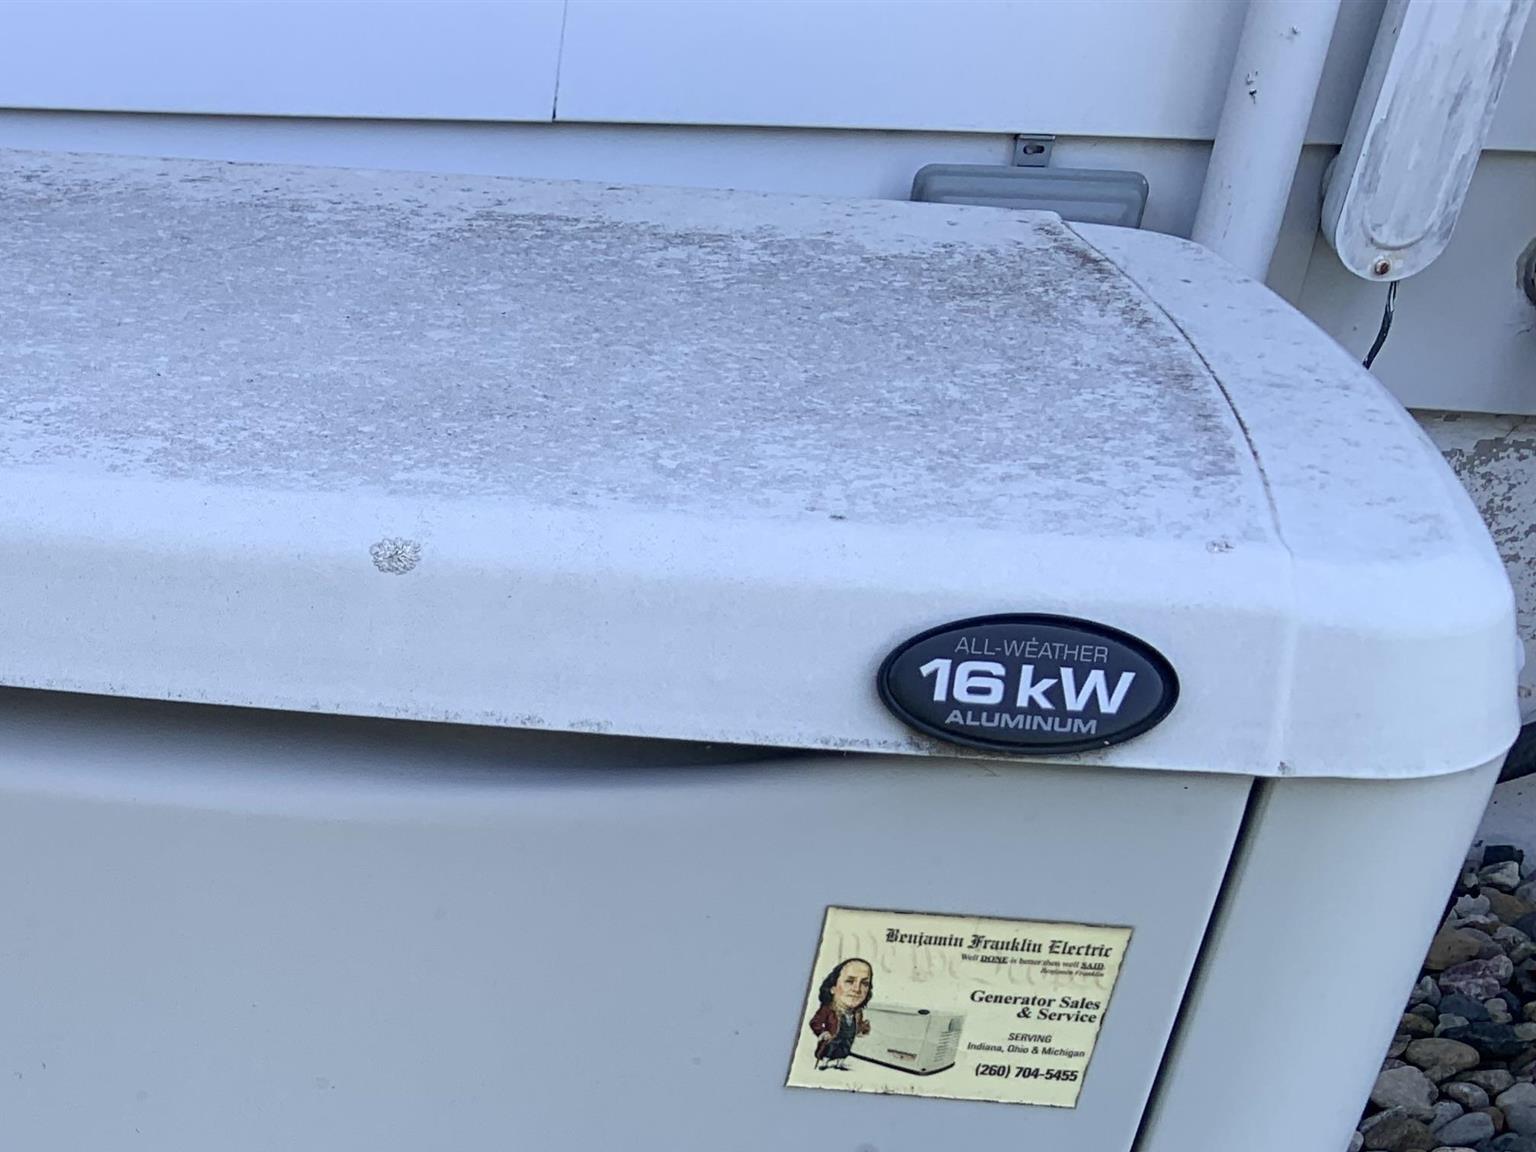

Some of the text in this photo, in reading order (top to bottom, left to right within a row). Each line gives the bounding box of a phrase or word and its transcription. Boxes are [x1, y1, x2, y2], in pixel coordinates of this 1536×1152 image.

[954, 637, 1109, 664] ALL-WEATHER
[919, 657, 1137, 715] 16 kW
[944, 709, 1098, 735] ALUMINUM
[886, 928, 964, 947] Benjamin
[967, 935, 1043, 953] Franklin
[1048, 940, 1112, 957] Electric
[980, 955, 1008, 964] DONE
[970, 990, 1101, 1010] Generator Sales
[1016, 1006, 1097, 1023] & Service
[1008, 1033, 1052, 1043] SERVING
[967, 1042, 1085, 1058] Indiana, Ohio & Michigan
[975, 1063, 1079, 1081] (260) 704-5455
